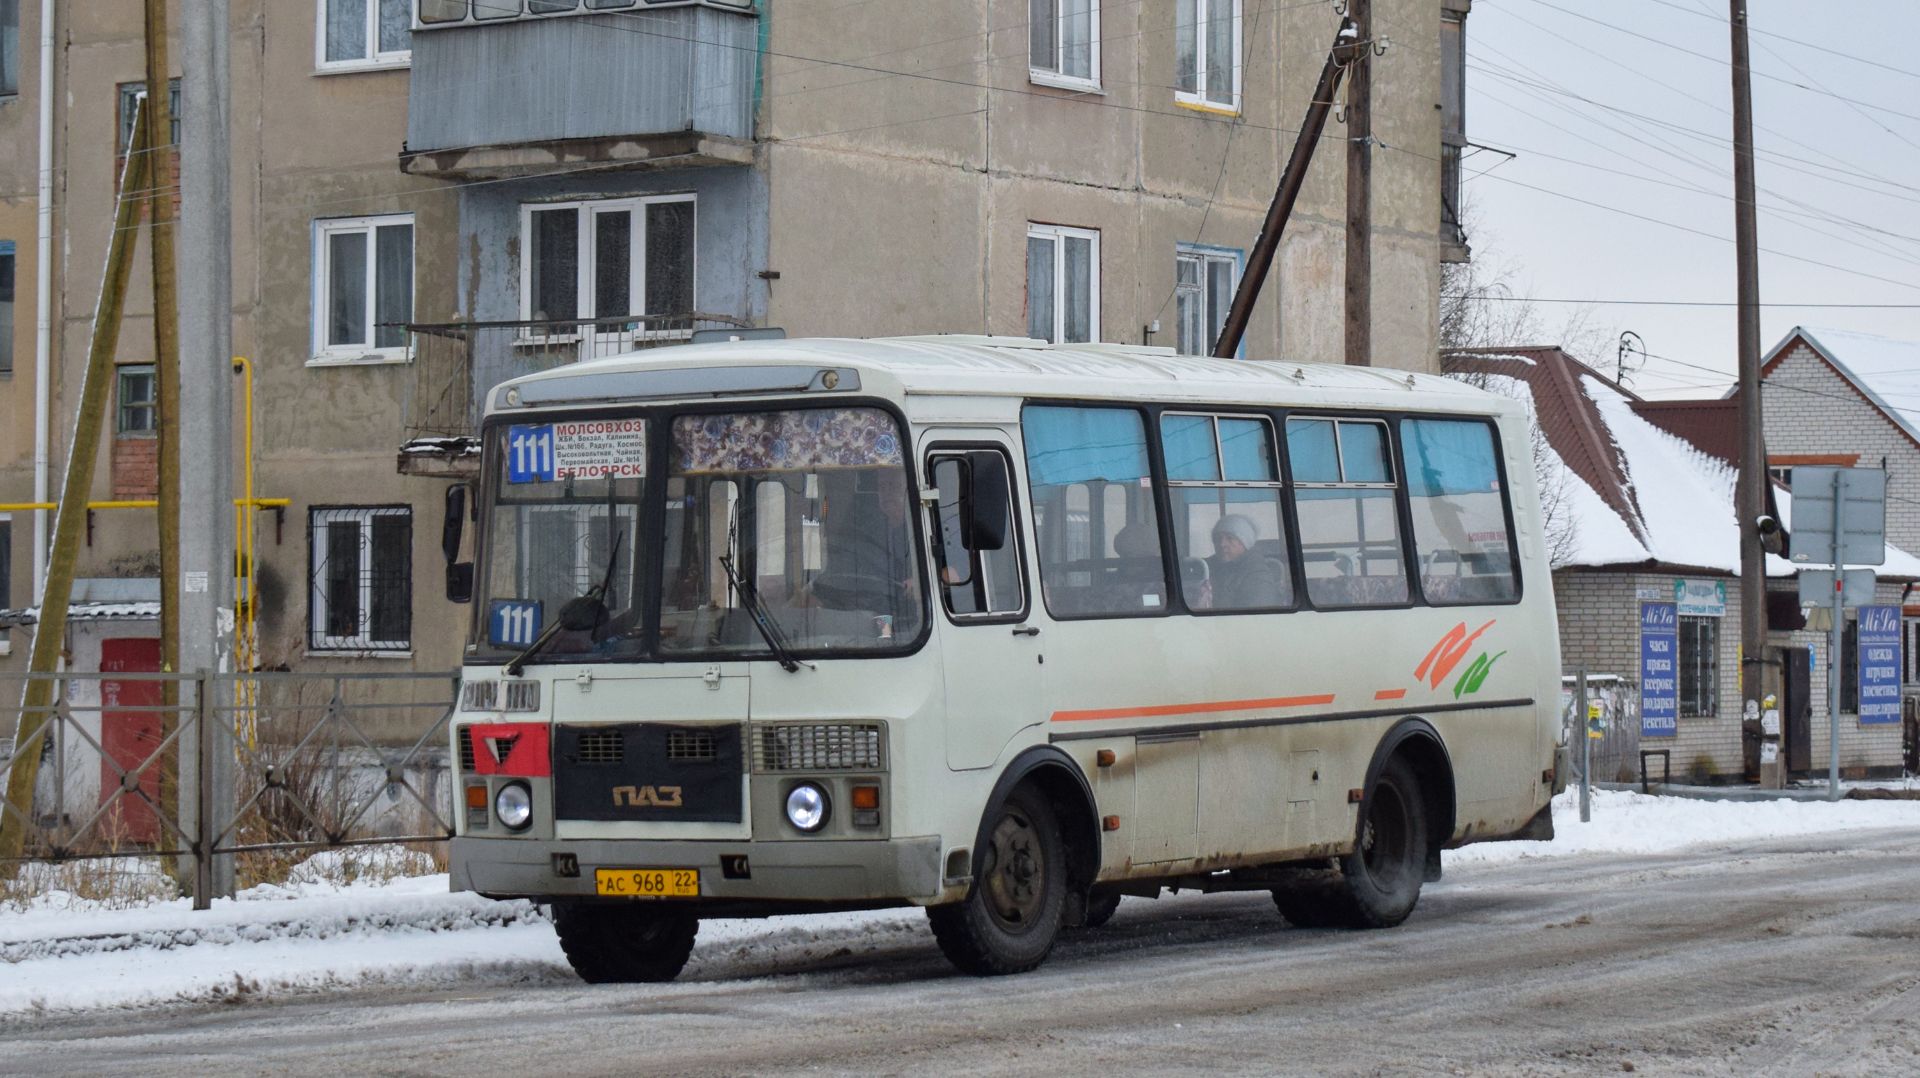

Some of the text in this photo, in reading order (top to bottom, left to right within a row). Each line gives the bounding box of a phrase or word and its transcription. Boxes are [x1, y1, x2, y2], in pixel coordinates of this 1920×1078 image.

[557, 421, 641, 436] МОЛСОВХОЗ
[512, 433, 550, 473] 111
[590, 441, 615, 450] Радуга,
[617, 440, 645, 449] Космос,
[557, 464, 641, 478] БЕЛОЯРСК
[500, 604, 534, 644] 111
[1649, 640, 1669, 652] часы
[1867, 648, 1893, 662] одежда
[1646, 659, 1672, 675] пряжа
[1644, 679, 1674, 695] ксерокс
[1643, 697, 1675, 714] подарки
[1642, 716, 1676, 729] текстиль
[612, 785, 682, 807] ПАЗ
[633, 873, 665, 892] 968
[675, 872, 691, 887] 22
